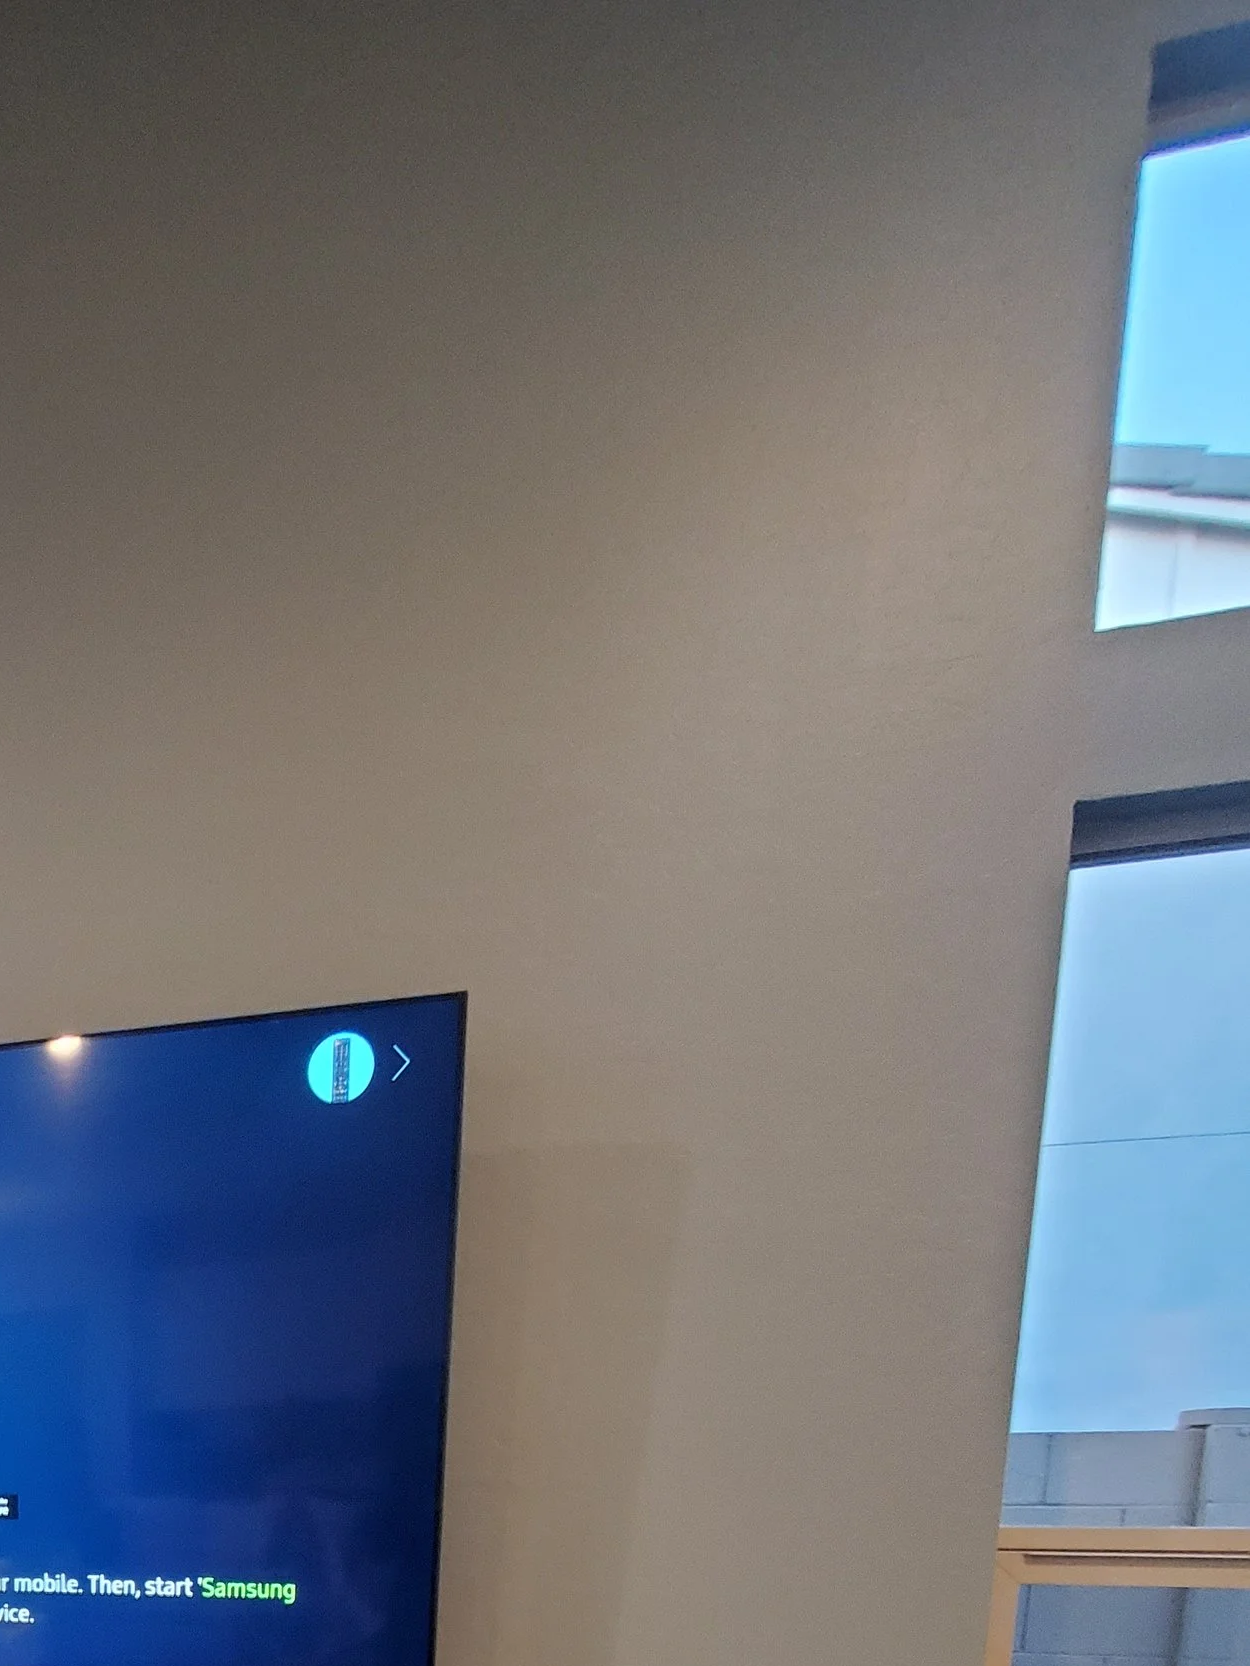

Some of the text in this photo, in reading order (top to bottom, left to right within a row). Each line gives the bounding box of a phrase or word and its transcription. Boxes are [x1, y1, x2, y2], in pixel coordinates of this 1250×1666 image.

[13, 1571, 83, 1595] mobile.
[87, 1573, 141, 1600] Then,
[144, 1577, 194, 1598] start
[197, 1576, 297, 1606] 'Samsung
